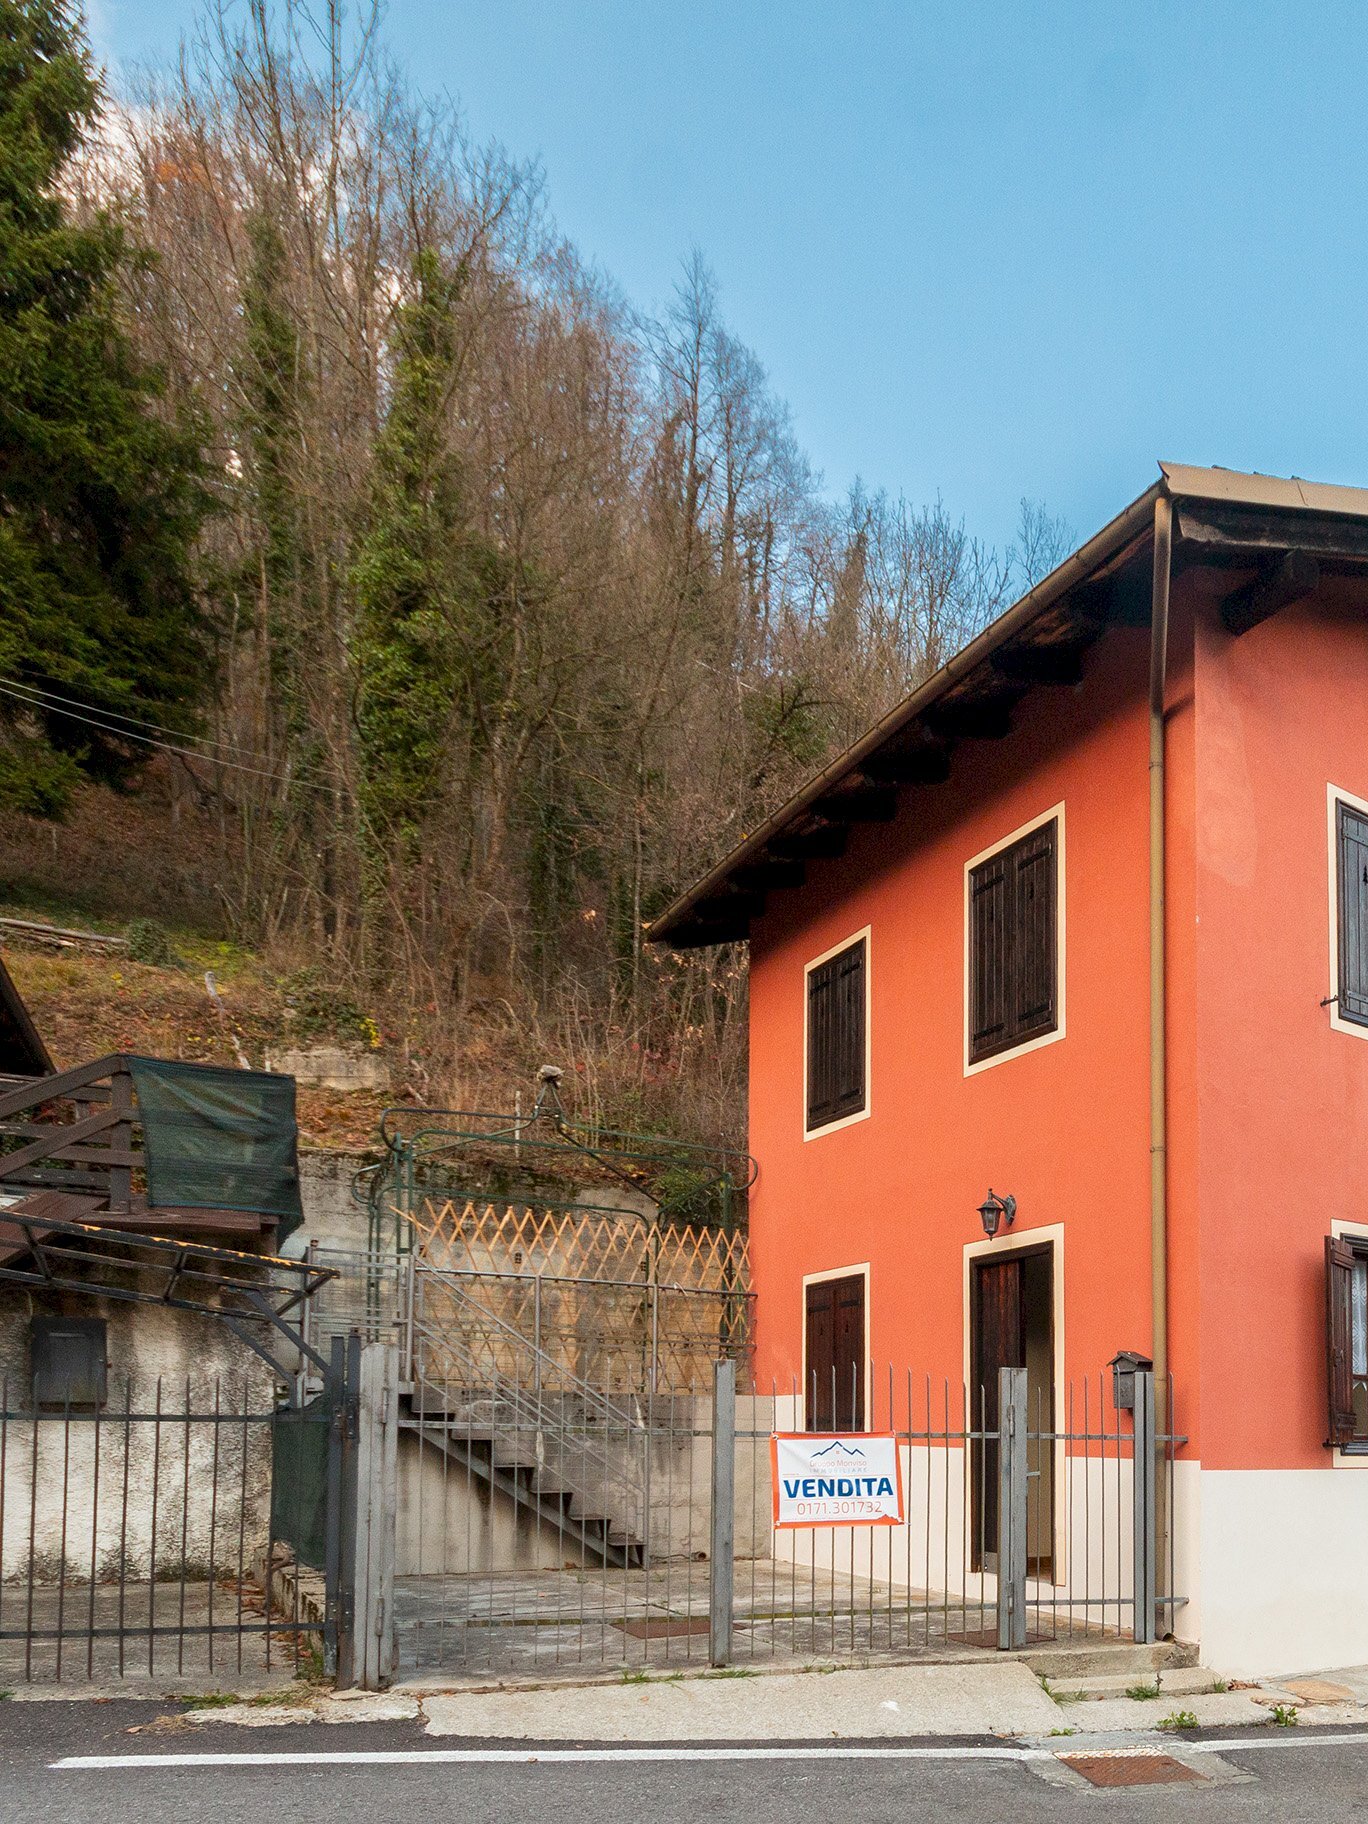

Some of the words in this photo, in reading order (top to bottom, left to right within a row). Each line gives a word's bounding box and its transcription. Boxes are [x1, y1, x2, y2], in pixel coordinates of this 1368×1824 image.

[837, 1459, 867, 1467] Monviso
[784, 1477, 893, 1498] VENDITA
[797, 1502, 882, 1515] 0171.301732
